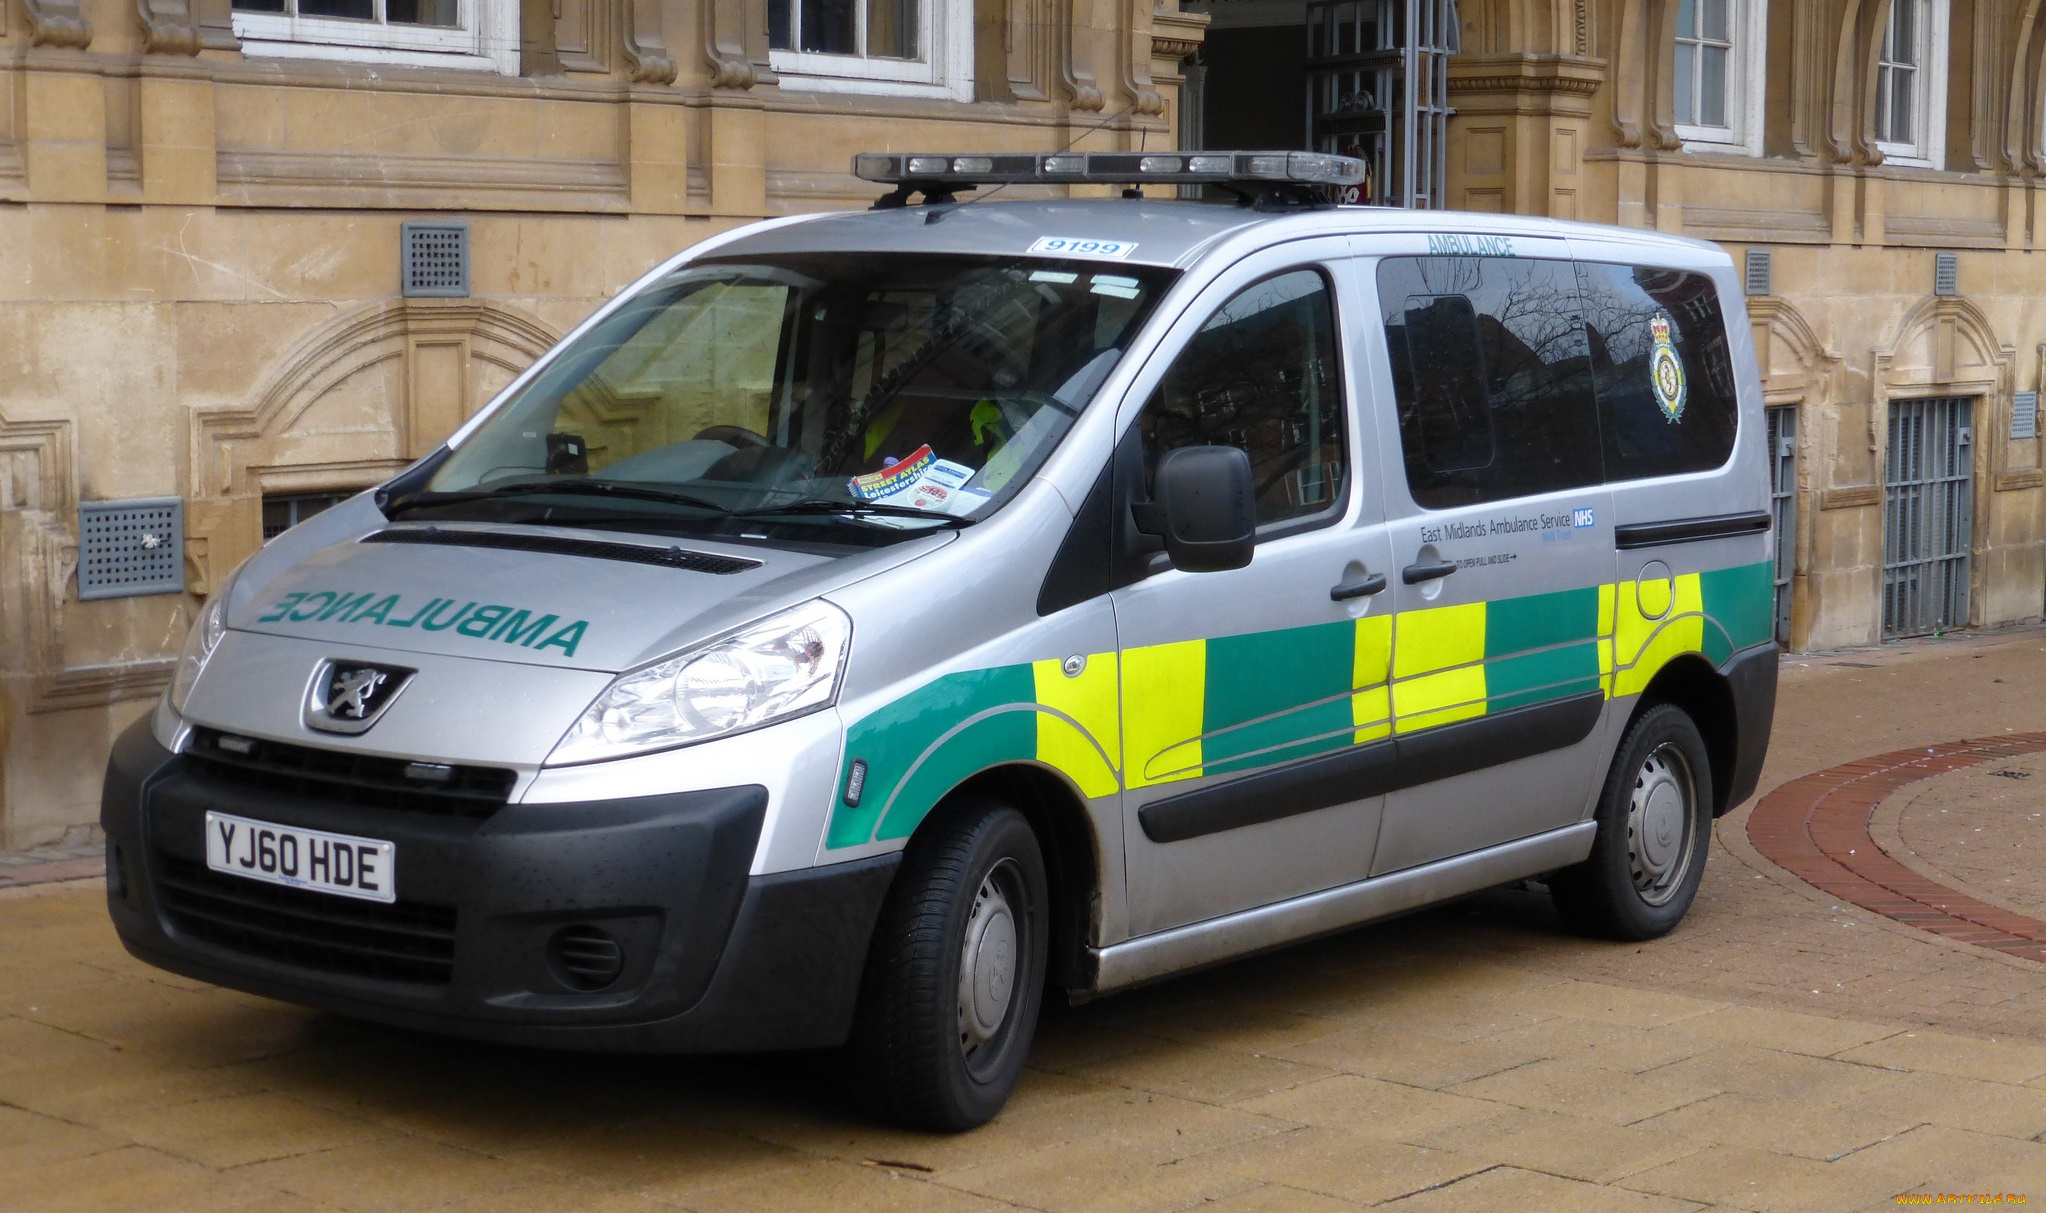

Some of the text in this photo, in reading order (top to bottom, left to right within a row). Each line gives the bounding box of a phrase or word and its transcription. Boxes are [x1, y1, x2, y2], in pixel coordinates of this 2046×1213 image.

[1045, 240, 1120, 255] 9199
[1428, 235, 1516, 257] AMBULANCE
[861, 475, 898, 492] STREET
[900, 457, 930, 479] ATLAS
[864, 464, 932, 499] Leicestershir
[1421, 508, 1593, 543] East Midlands Ambulance Service NHS
[1463, 558, 1475, 568] OPEN
[1476, 556, 1487, 566] PULL
[1487, 555, 1497, 565] AND
[1497, 553, 1510, 563] SLIDE
[219, 821, 378, 891] YJ60 HDE
